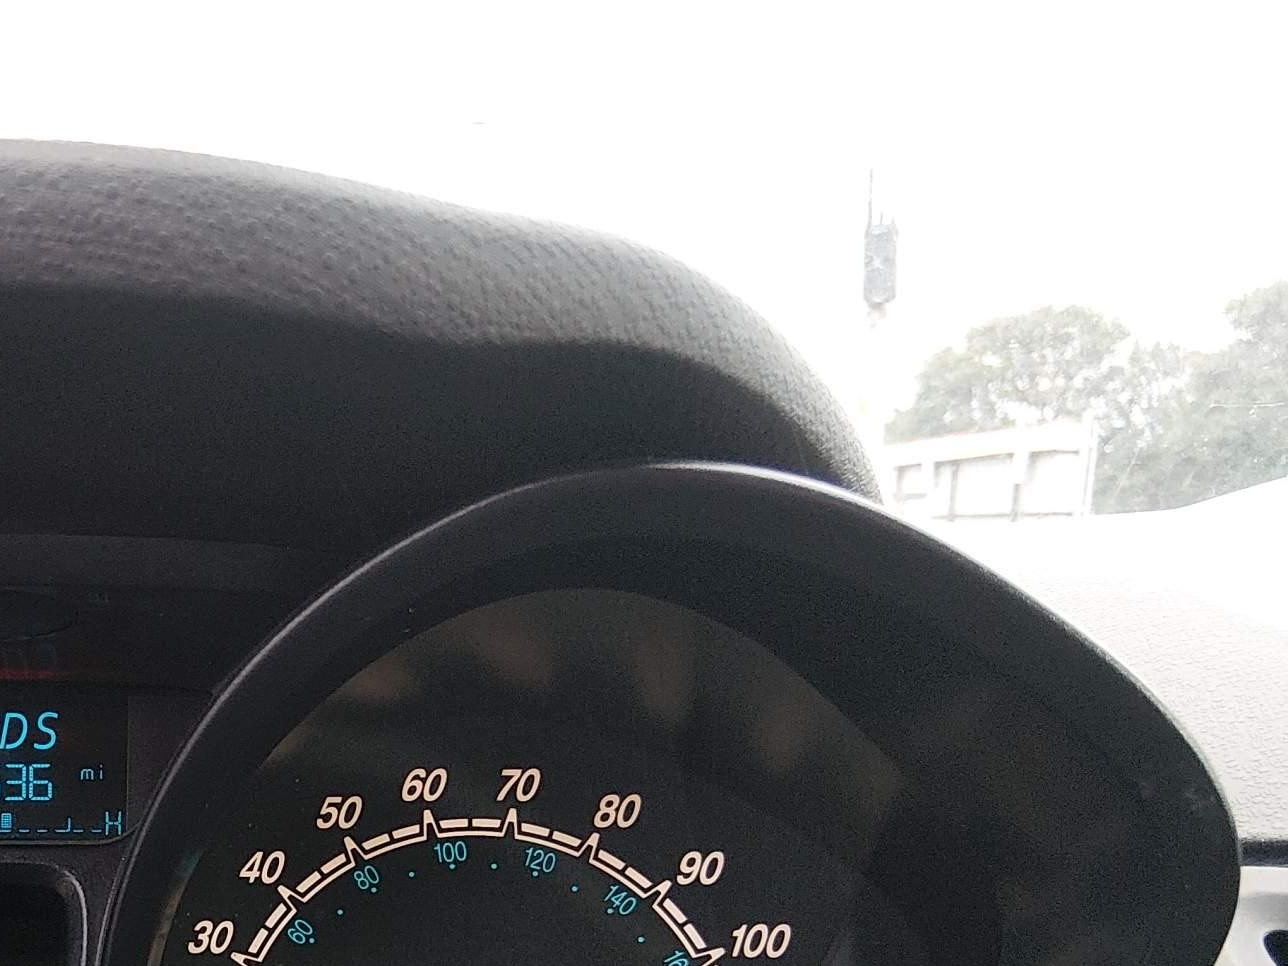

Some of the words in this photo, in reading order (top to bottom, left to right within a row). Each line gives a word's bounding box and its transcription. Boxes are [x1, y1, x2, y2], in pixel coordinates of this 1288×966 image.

[80, 764, 104, 781] mi
[400, 767, 448, 802] 60
[496, 768, 541, 802] 70
[315, 795, 363, 829] 50
[593, 794, 642, 828] 80
[239, 850, 286, 884] 40
[433, 841, 468, 862] 100
[524, 848, 556, 872] 120
[676, 851, 725, 886] 90
[354, 865, 379, 889] 80
[604, 885, 637, 915] 140
[187, 920, 234, 954] 30
[287, 919, 313, 944] 60
[731, 924, 792, 958] 100
